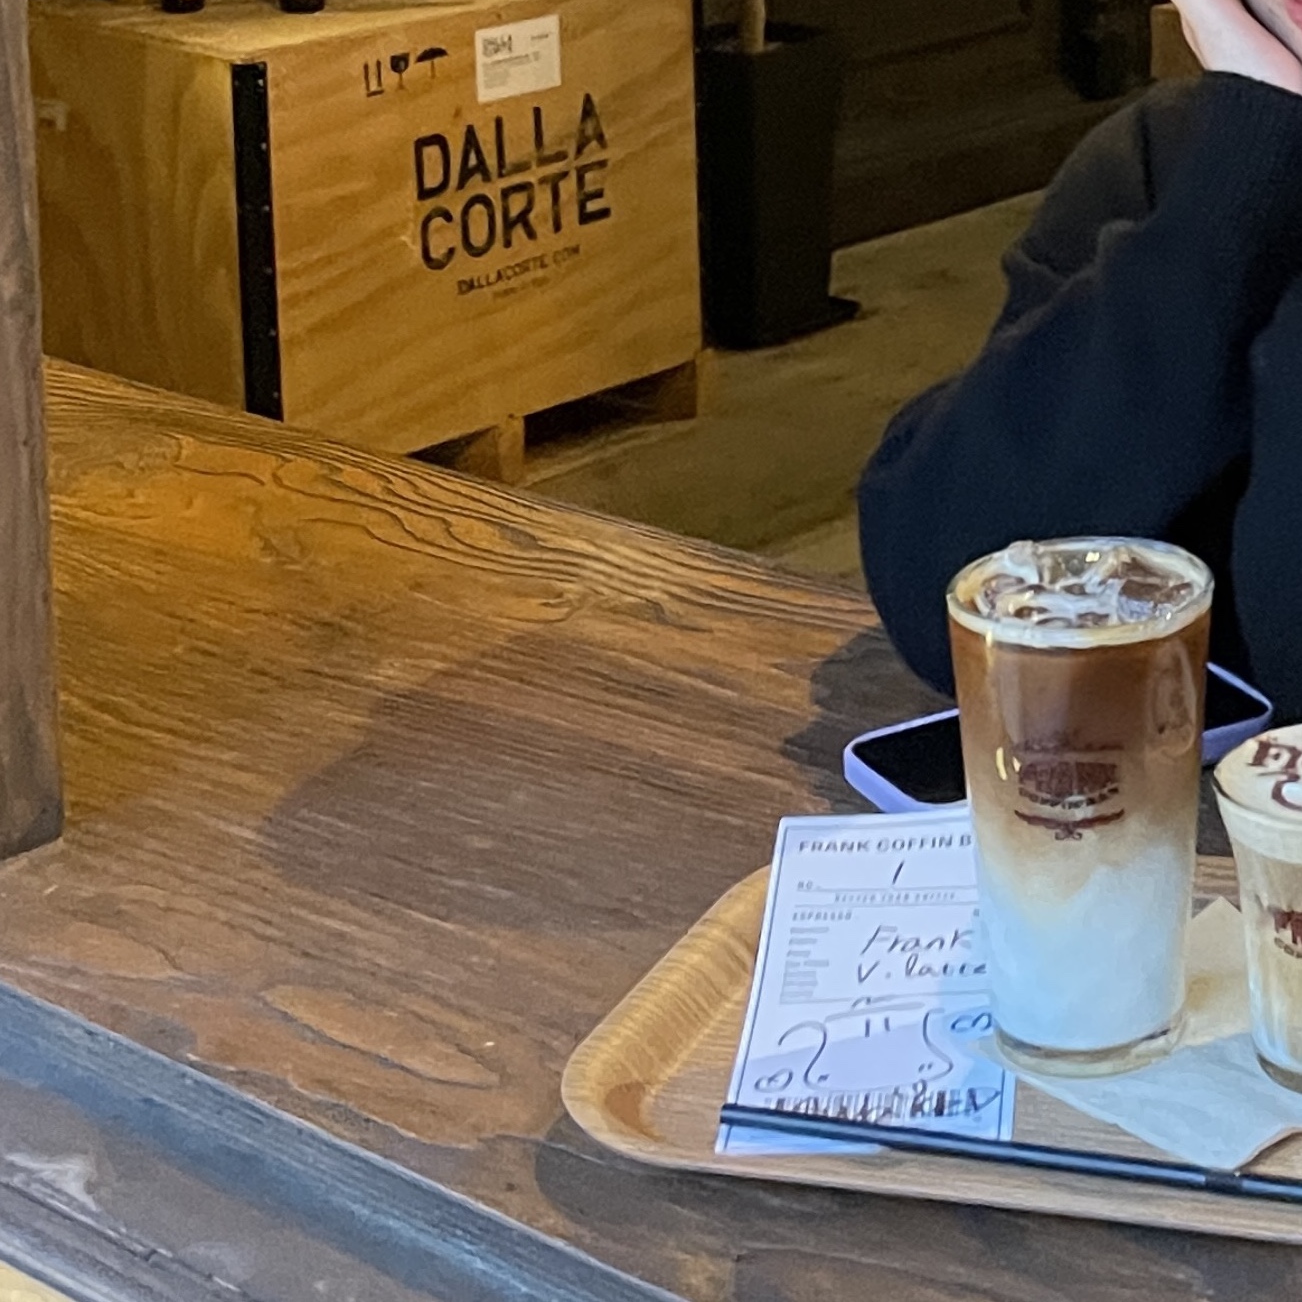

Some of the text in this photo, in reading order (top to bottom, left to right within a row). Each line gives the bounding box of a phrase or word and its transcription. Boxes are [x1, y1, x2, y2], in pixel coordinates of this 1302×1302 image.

[413, 92, 609, 201] DALLA
[420, 158, 612, 271] CORTE
[798, 839, 871, 853] FRANK
[876, 834, 953, 852] COFFIN
